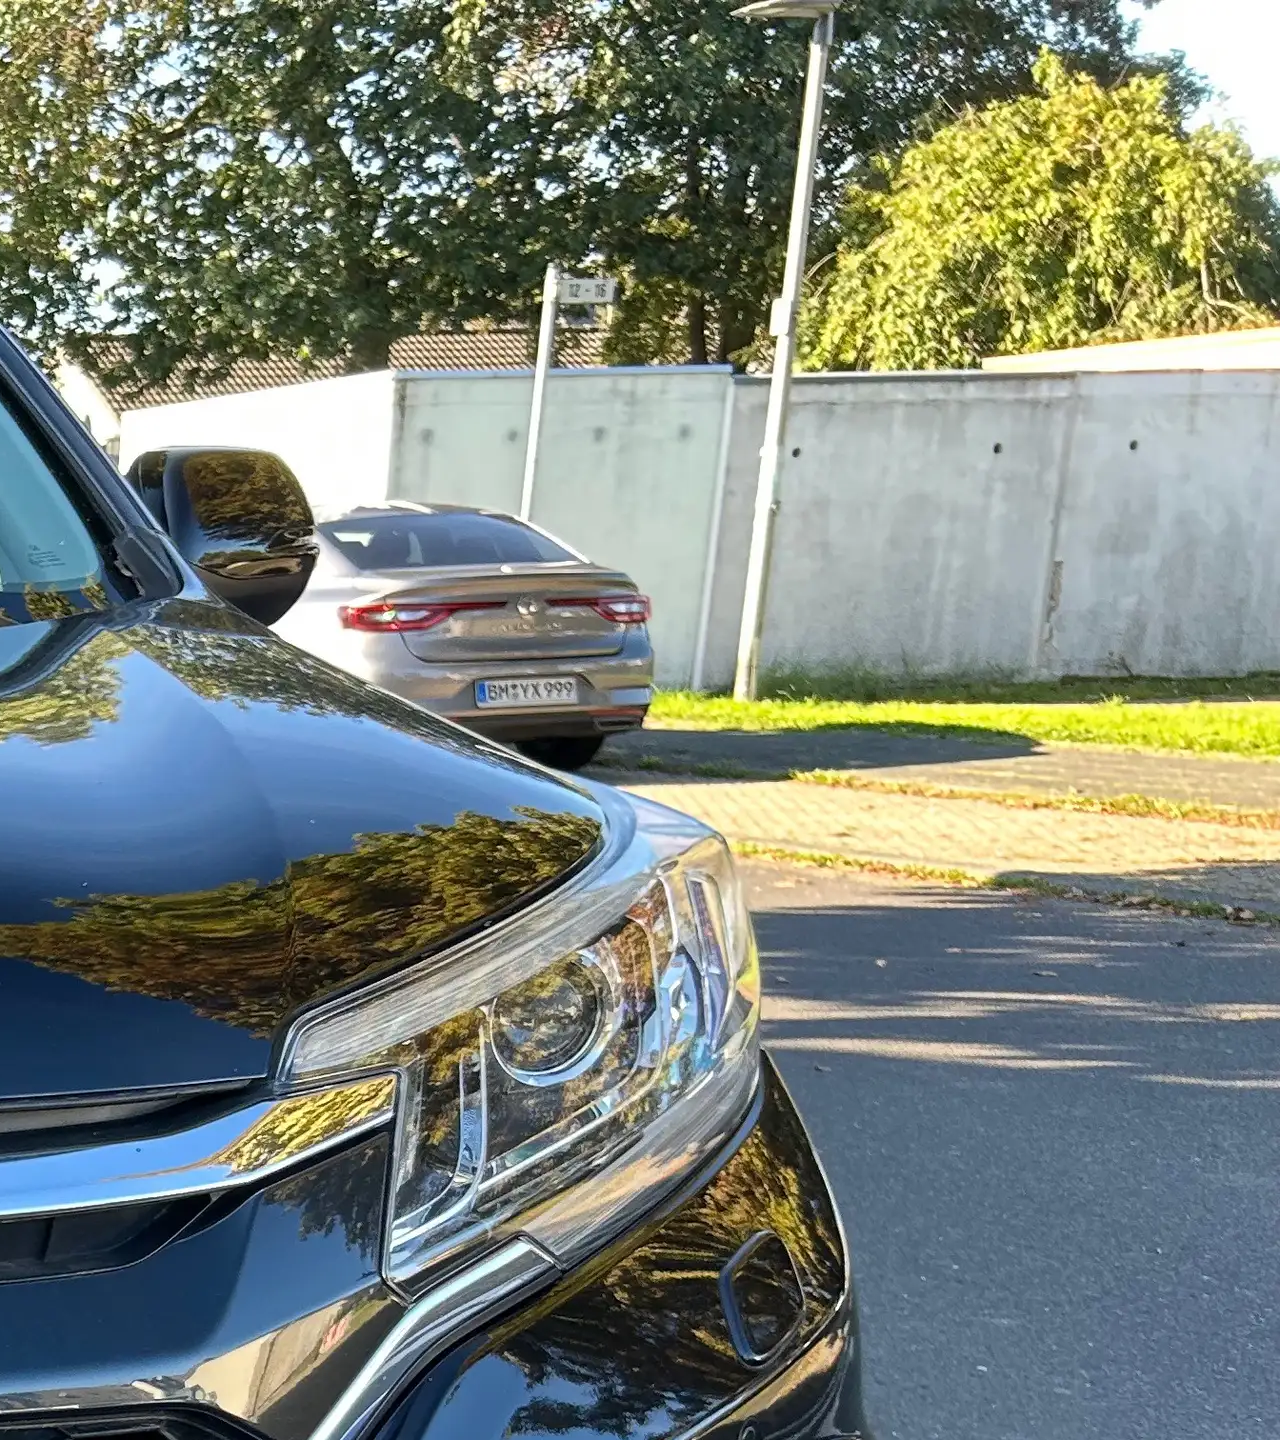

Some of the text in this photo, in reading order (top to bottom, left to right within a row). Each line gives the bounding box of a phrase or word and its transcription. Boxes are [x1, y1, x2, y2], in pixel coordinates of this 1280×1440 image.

[488, 681, 574, 701] BM YX 999
